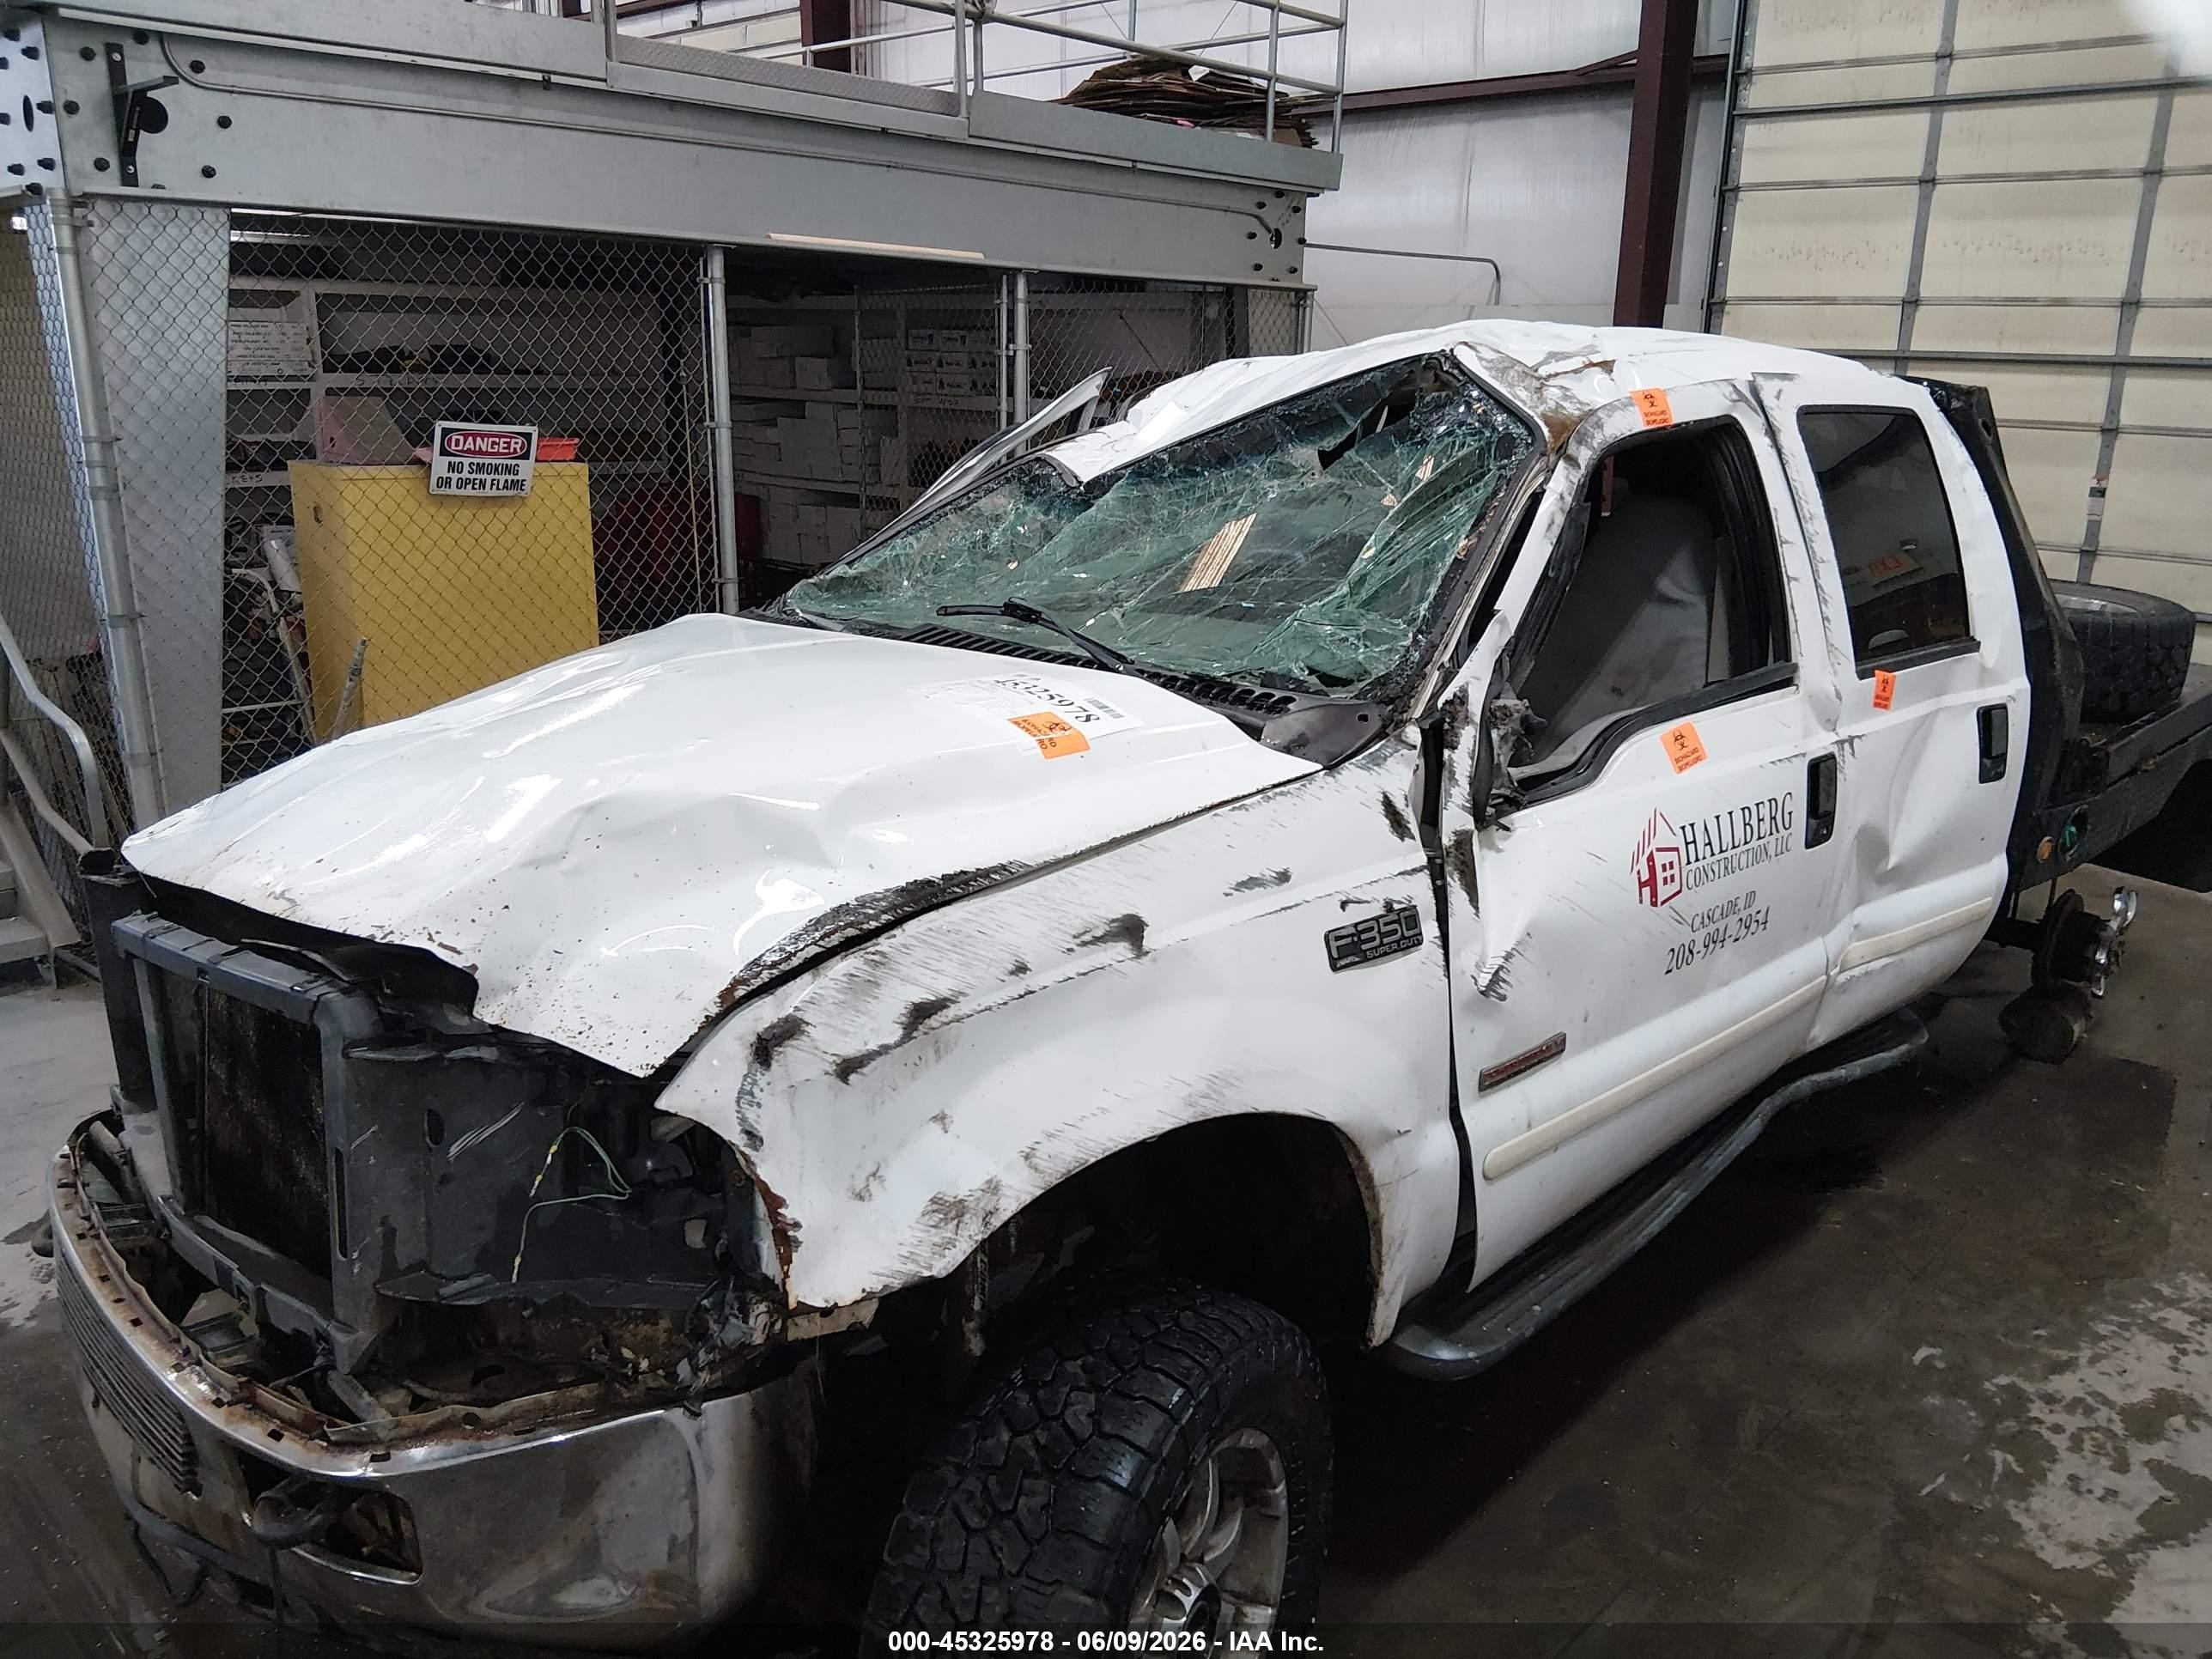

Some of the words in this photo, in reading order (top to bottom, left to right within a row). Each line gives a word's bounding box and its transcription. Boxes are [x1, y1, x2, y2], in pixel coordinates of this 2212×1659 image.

[451, 435, 523, 453] DANGER
[435, 476, 453, 489] OR
[455, 477, 487, 490] OPEN
[489, 478, 526, 492] FLAME
[447, 460, 465, 474] NO
[467, 462, 520, 476] SMOKING
[994, 678, 1101, 723] 45325978
[1679, 792, 1794, 866] HALLBERG
[1686, 841, 1772, 890] CONSTRUCTION,
[1774, 832, 1793, 858] LLC
[1691, 896, 1741, 933] CASCADE,
[1743, 890, 1757, 910] ID
[1366, 944, 1399, 959] SUPER
[1664, 905, 1771, 975] 208-994-2954
